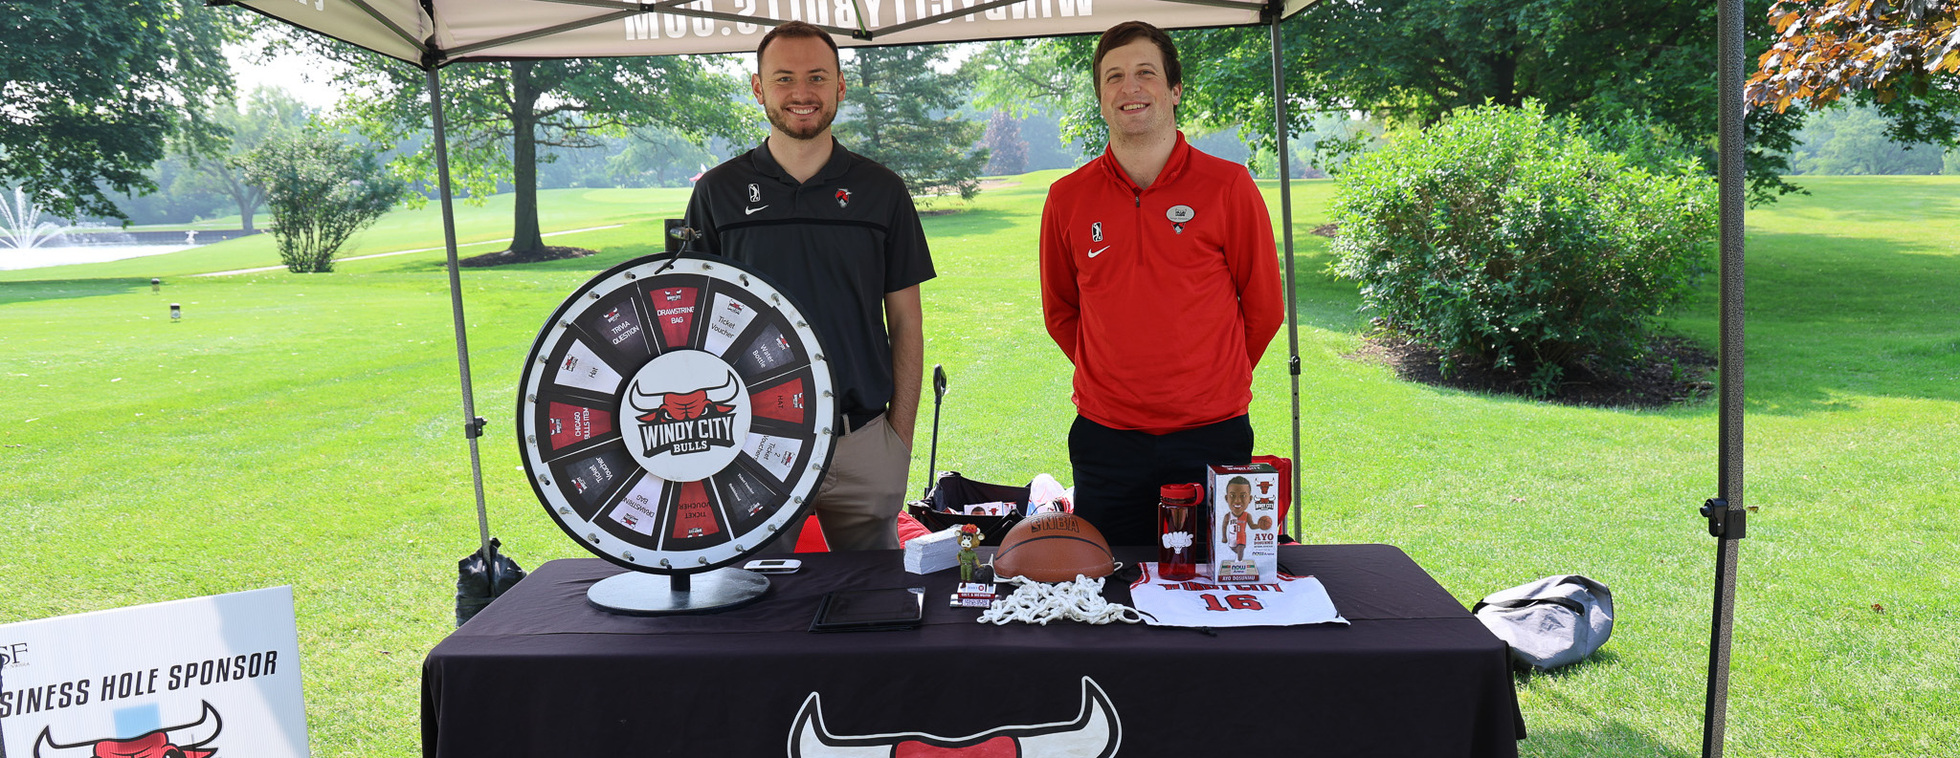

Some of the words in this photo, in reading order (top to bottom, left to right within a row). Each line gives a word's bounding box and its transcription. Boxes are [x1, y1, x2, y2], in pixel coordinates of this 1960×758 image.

[611, 320, 631, 335] TRIVIA
[711, 323, 735, 339] Voucher
[718, 316, 736, 329] Ticket
[612, 325, 640, 345] QUESTION
[752, 349, 767, 369] Bottle
[760, 343, 775, 363] Water
[573, 411, 582, 437] CHICAGO
[642, 420, 694, 451] WINDY
[698, 416, 732, 441] CITY
[673, 440, 708, 453] BULLS
[763, 443, 776, 460] Ticket
[589, 464, 604, 483] Ticket
[595, 456, 613, 480] Voucher
[636, 494, 649, 504] BAG
[685, 511, 707, 519] TICKET
[1043, 516, 1080, 533] NBA
[1253, 533, 1274, 541] AYO
[1200, 593, 1264, 611] 16
[101, 668, 159, 701] HOLE
[167, 650, 278, 691] SPONSOR
